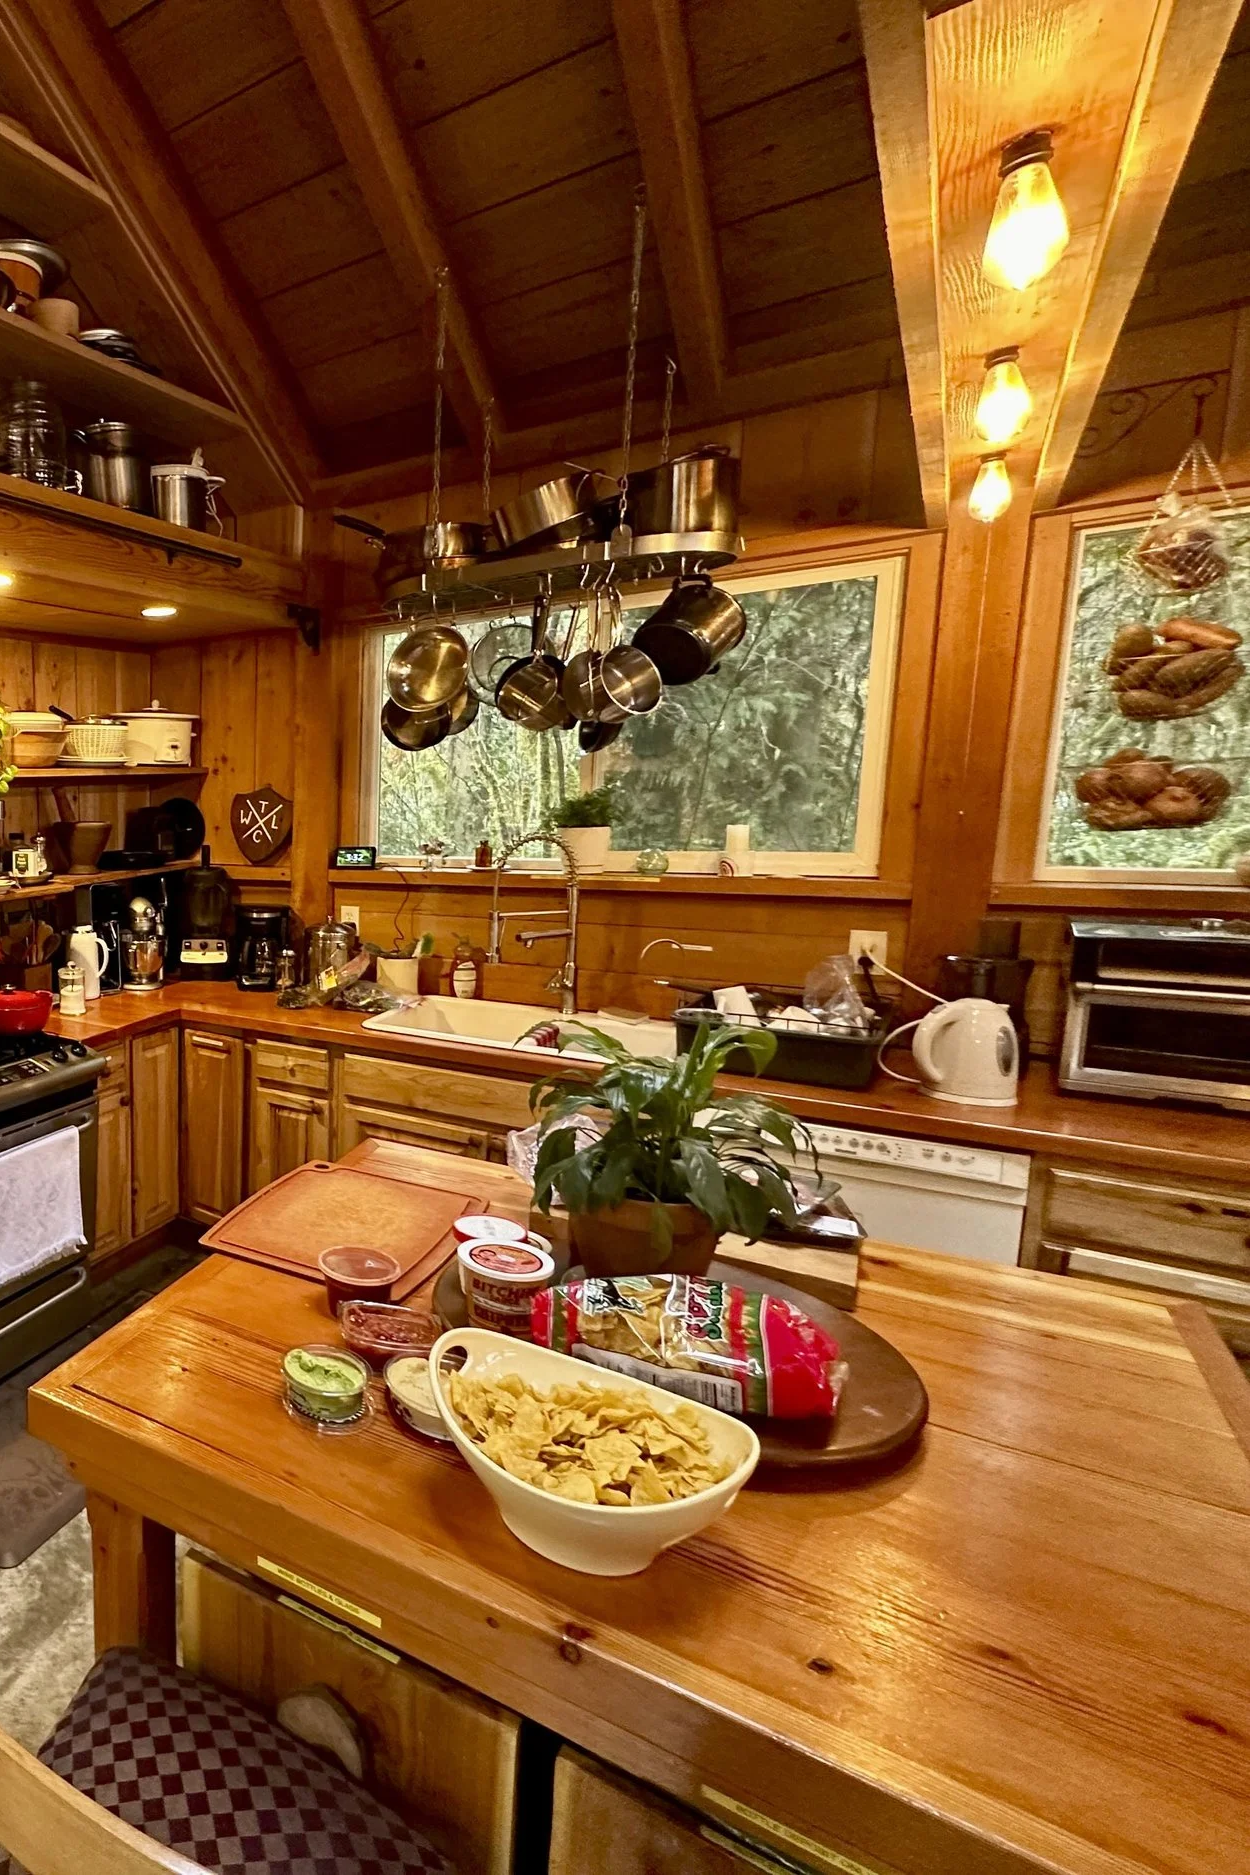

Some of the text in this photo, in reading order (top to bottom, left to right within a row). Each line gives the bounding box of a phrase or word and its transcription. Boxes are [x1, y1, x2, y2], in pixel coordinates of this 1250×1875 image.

[259, 801, 268, 813] T
[240, 810, 252, 825] W
[271, 815, 279, 829] L
[253, 829, 263, 843] C
